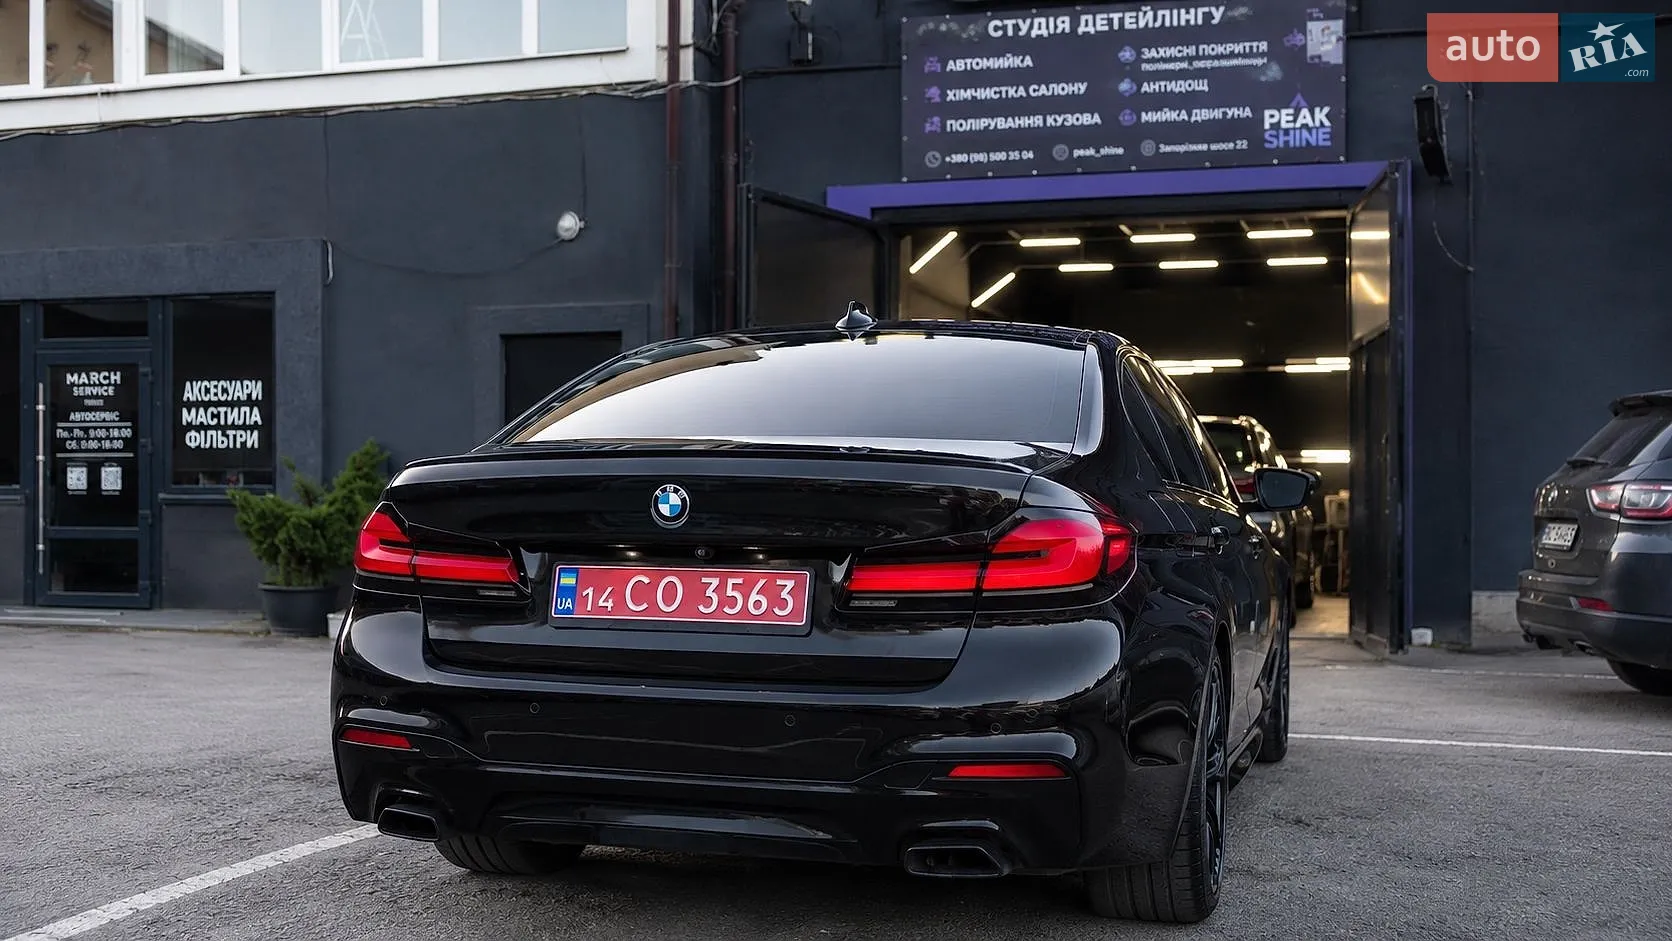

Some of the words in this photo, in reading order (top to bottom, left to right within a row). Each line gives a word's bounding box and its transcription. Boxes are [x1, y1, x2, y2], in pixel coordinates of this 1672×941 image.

[987, 16, 1071, 38] СТУДІЯ
[1077, 6, 1225, 35] ДЕТЕЙЛІНГУ
[1140, 45, 1198, 59] ЗАХИСНІ
[1199, 41, 1268, 56] ПОКРИТТЯ
[946, 54, 1033, 71] АВТОМИЙКА
[946, 84, 1028, 102] ХІМЧИСТКА
[1029, 82, 1088, 97] САЛОНУ
[1141, 79, 1209, 94] АНТИДОЩ
[946, 115, 1043, 132] ПОЛІРУВАННЯ
[1046, 112, 1102, 127] КУЗОВА
[1141, 108, 1188, 123] МИЙКА
[1190, 106, 1252, 122] ДВИГУНА
[1263, 106, 1331, 129] PEAK
[1235, 139, 1248, 149] 22
[1264, 127, 1332, 148] SHINE
[1008, 150, 1020, 160] 35
[1021, 149, 1034, 160] 04
[1073, 146, 1125, 158] peak_shine
[66, 371, 121, 385] MARCH
[72, 386, 115, 396] SERVICE
[182, 379, 263, 402] АКСЕСУАРИ
[182, 406, 263, 426] МАСТИЛА
[185, 429, 259, 449] ФІЛЬТРИ
[557, 597, 573, 610] UA
[581, 586, 615, 612] 14
[624, 574, 684, 613] CO
[697, 577, 796, 616] 3563
